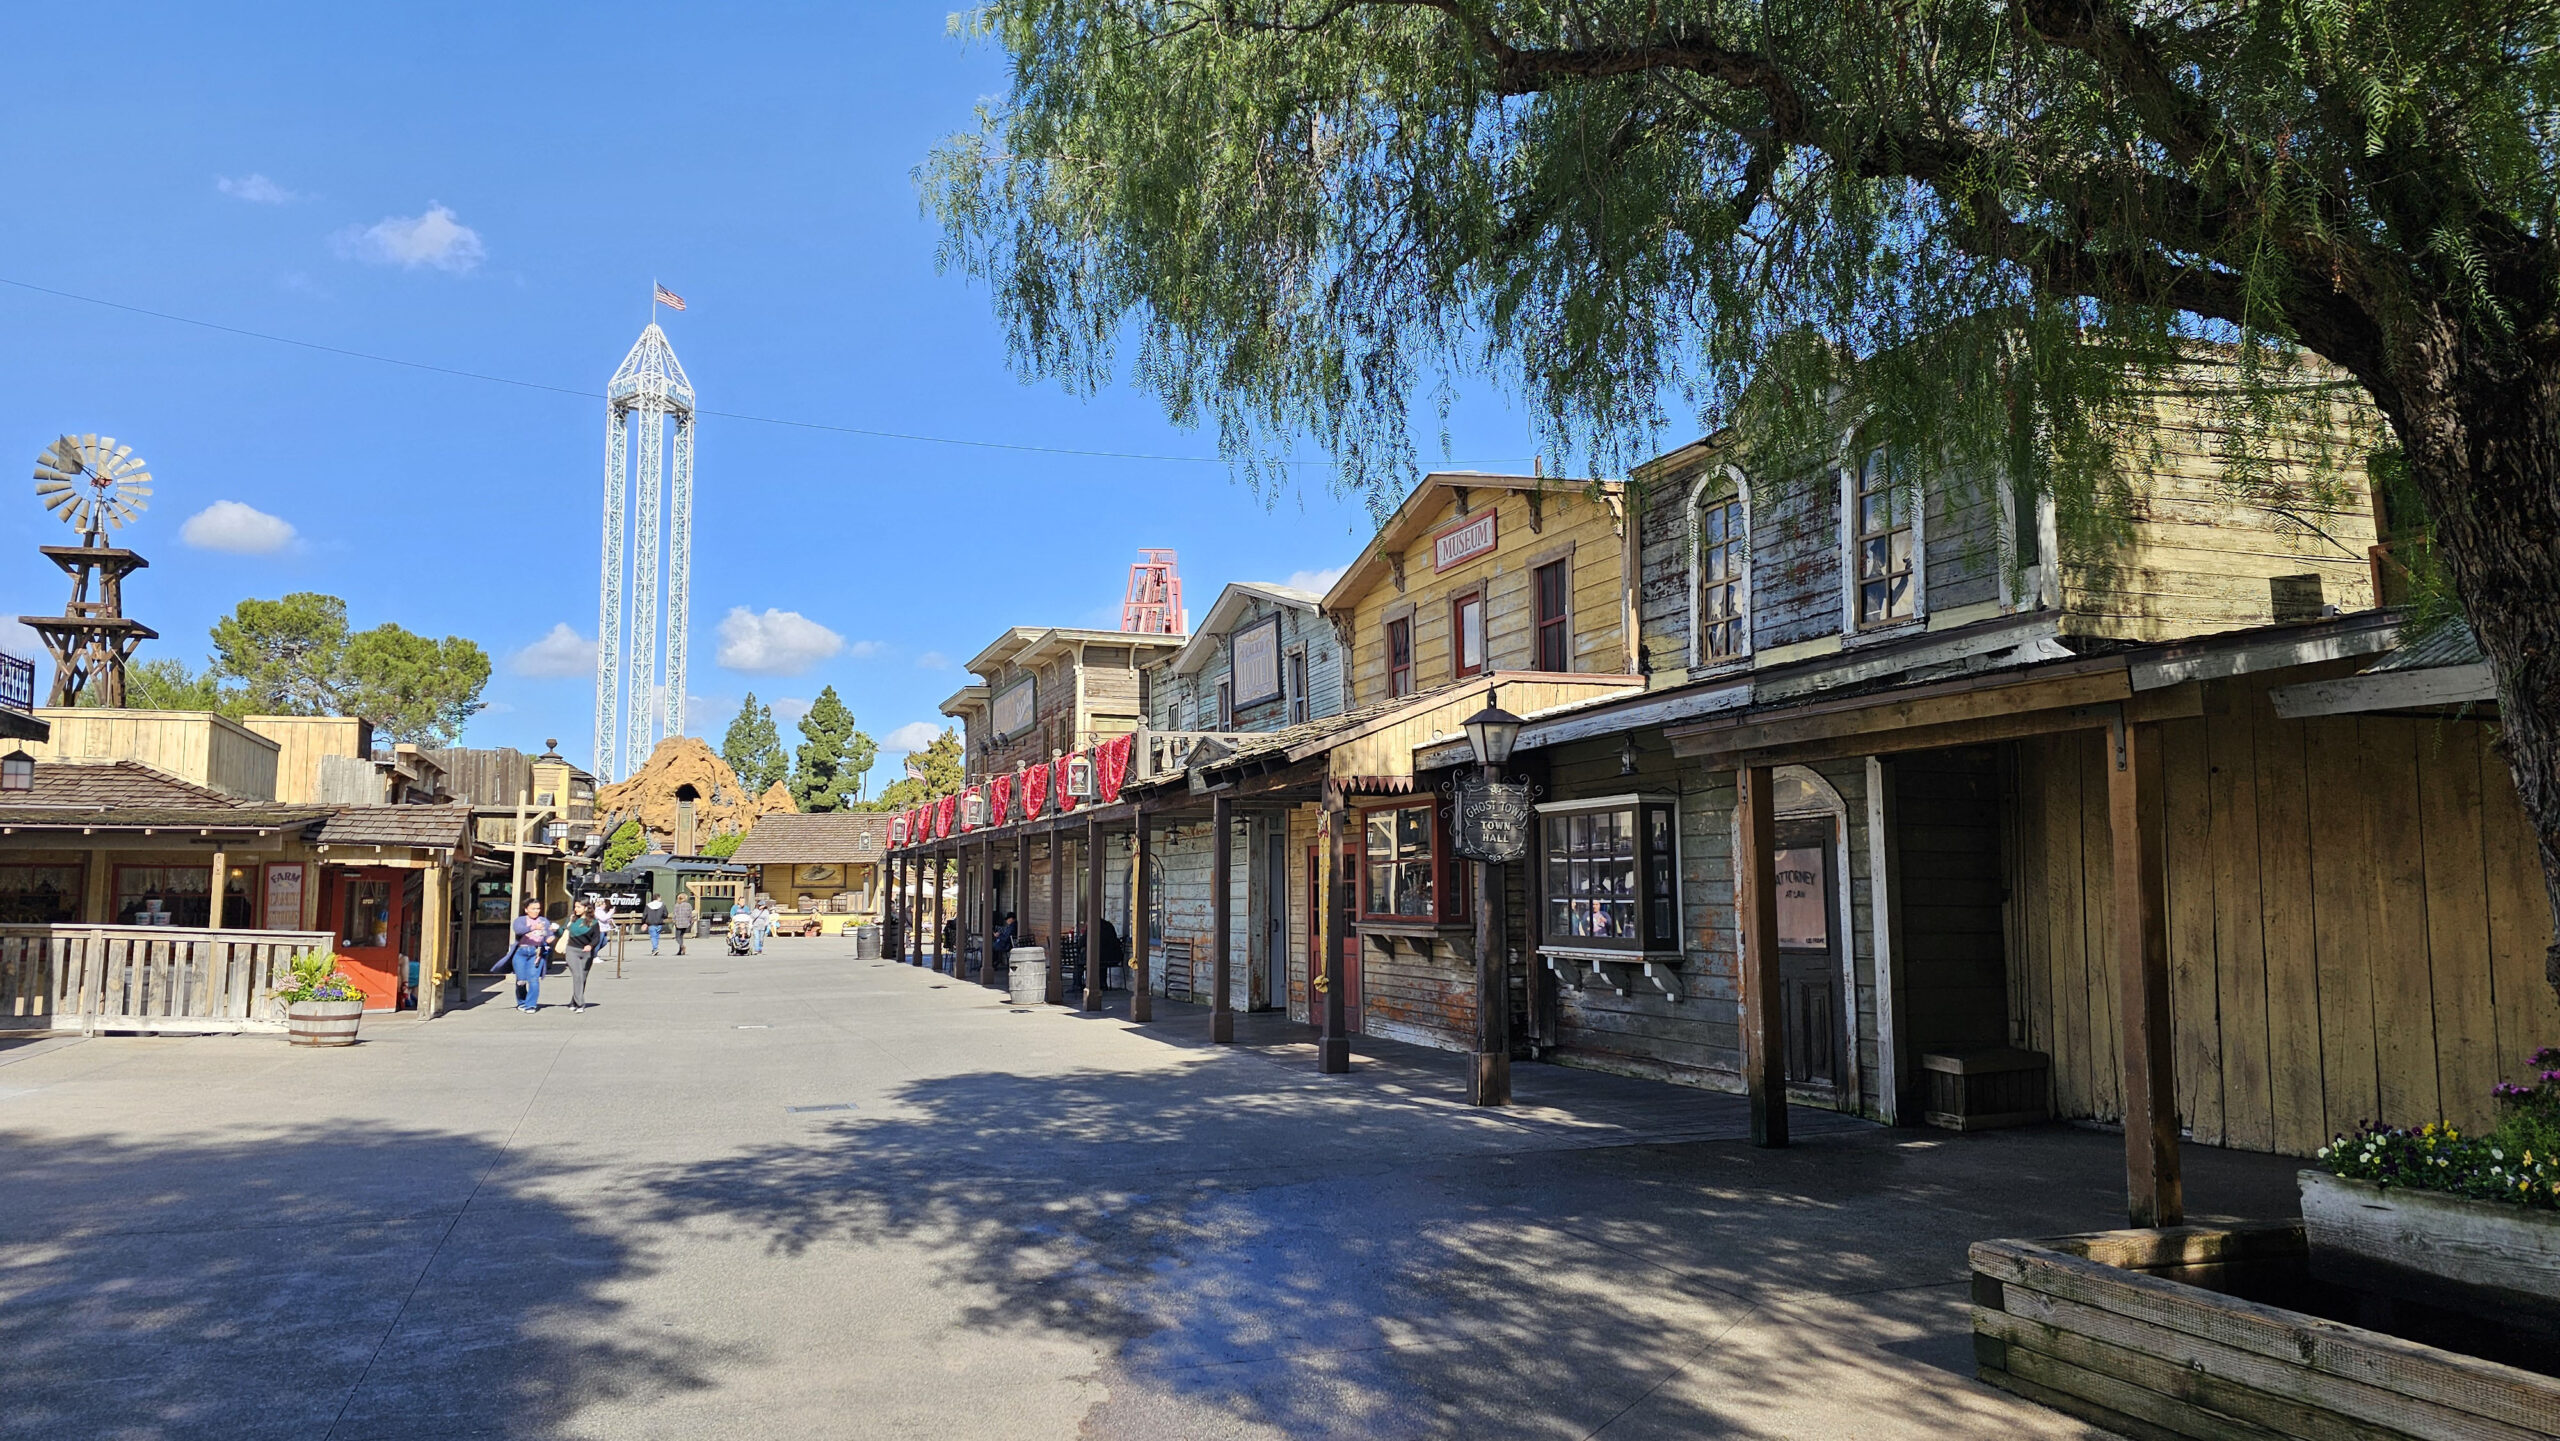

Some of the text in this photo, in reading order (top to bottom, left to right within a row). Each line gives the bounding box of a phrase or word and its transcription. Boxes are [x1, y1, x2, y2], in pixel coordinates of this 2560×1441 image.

[1442, 522, 1488, 560] MUSEUM
[1239, 654, 1273, 692] HOTEL
[1466, 800, 1527, 821] GHOST TOWN
[1480, 821, 1511, 831] TOWN
[1482, 833, 1510, 842] HALL
[271, 872, 301, 884] FARM
[1776, 869, 1816, 887] ATTORNEY
[609, 892, 641, 906] Grande
